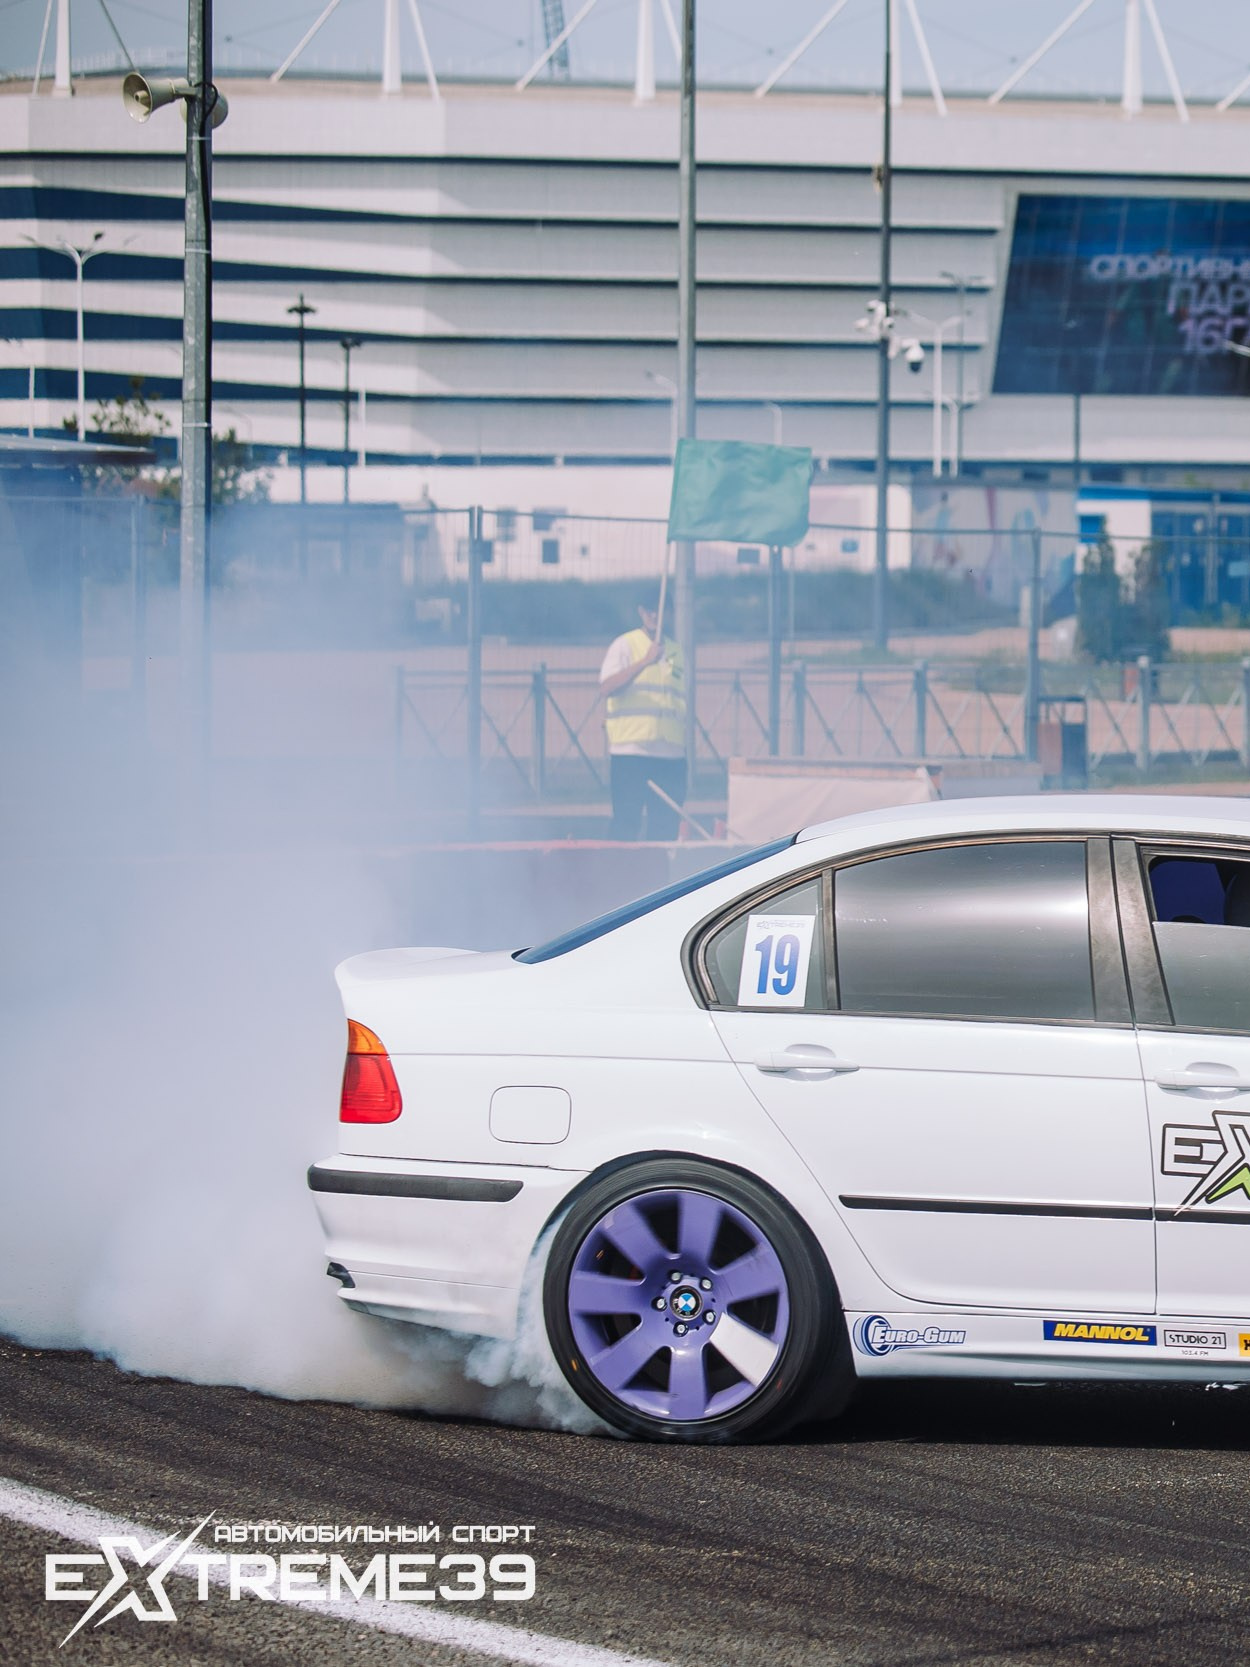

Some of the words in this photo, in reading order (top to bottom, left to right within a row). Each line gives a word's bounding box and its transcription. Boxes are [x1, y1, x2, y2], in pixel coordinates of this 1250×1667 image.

[755, 934, 801, 996] 19
[1053, 1322, 1149, 1342] MANNOL
[1168, 1334, 1209, 1346] STUDIO
[1211, 1336, 1222, 1345] 21
